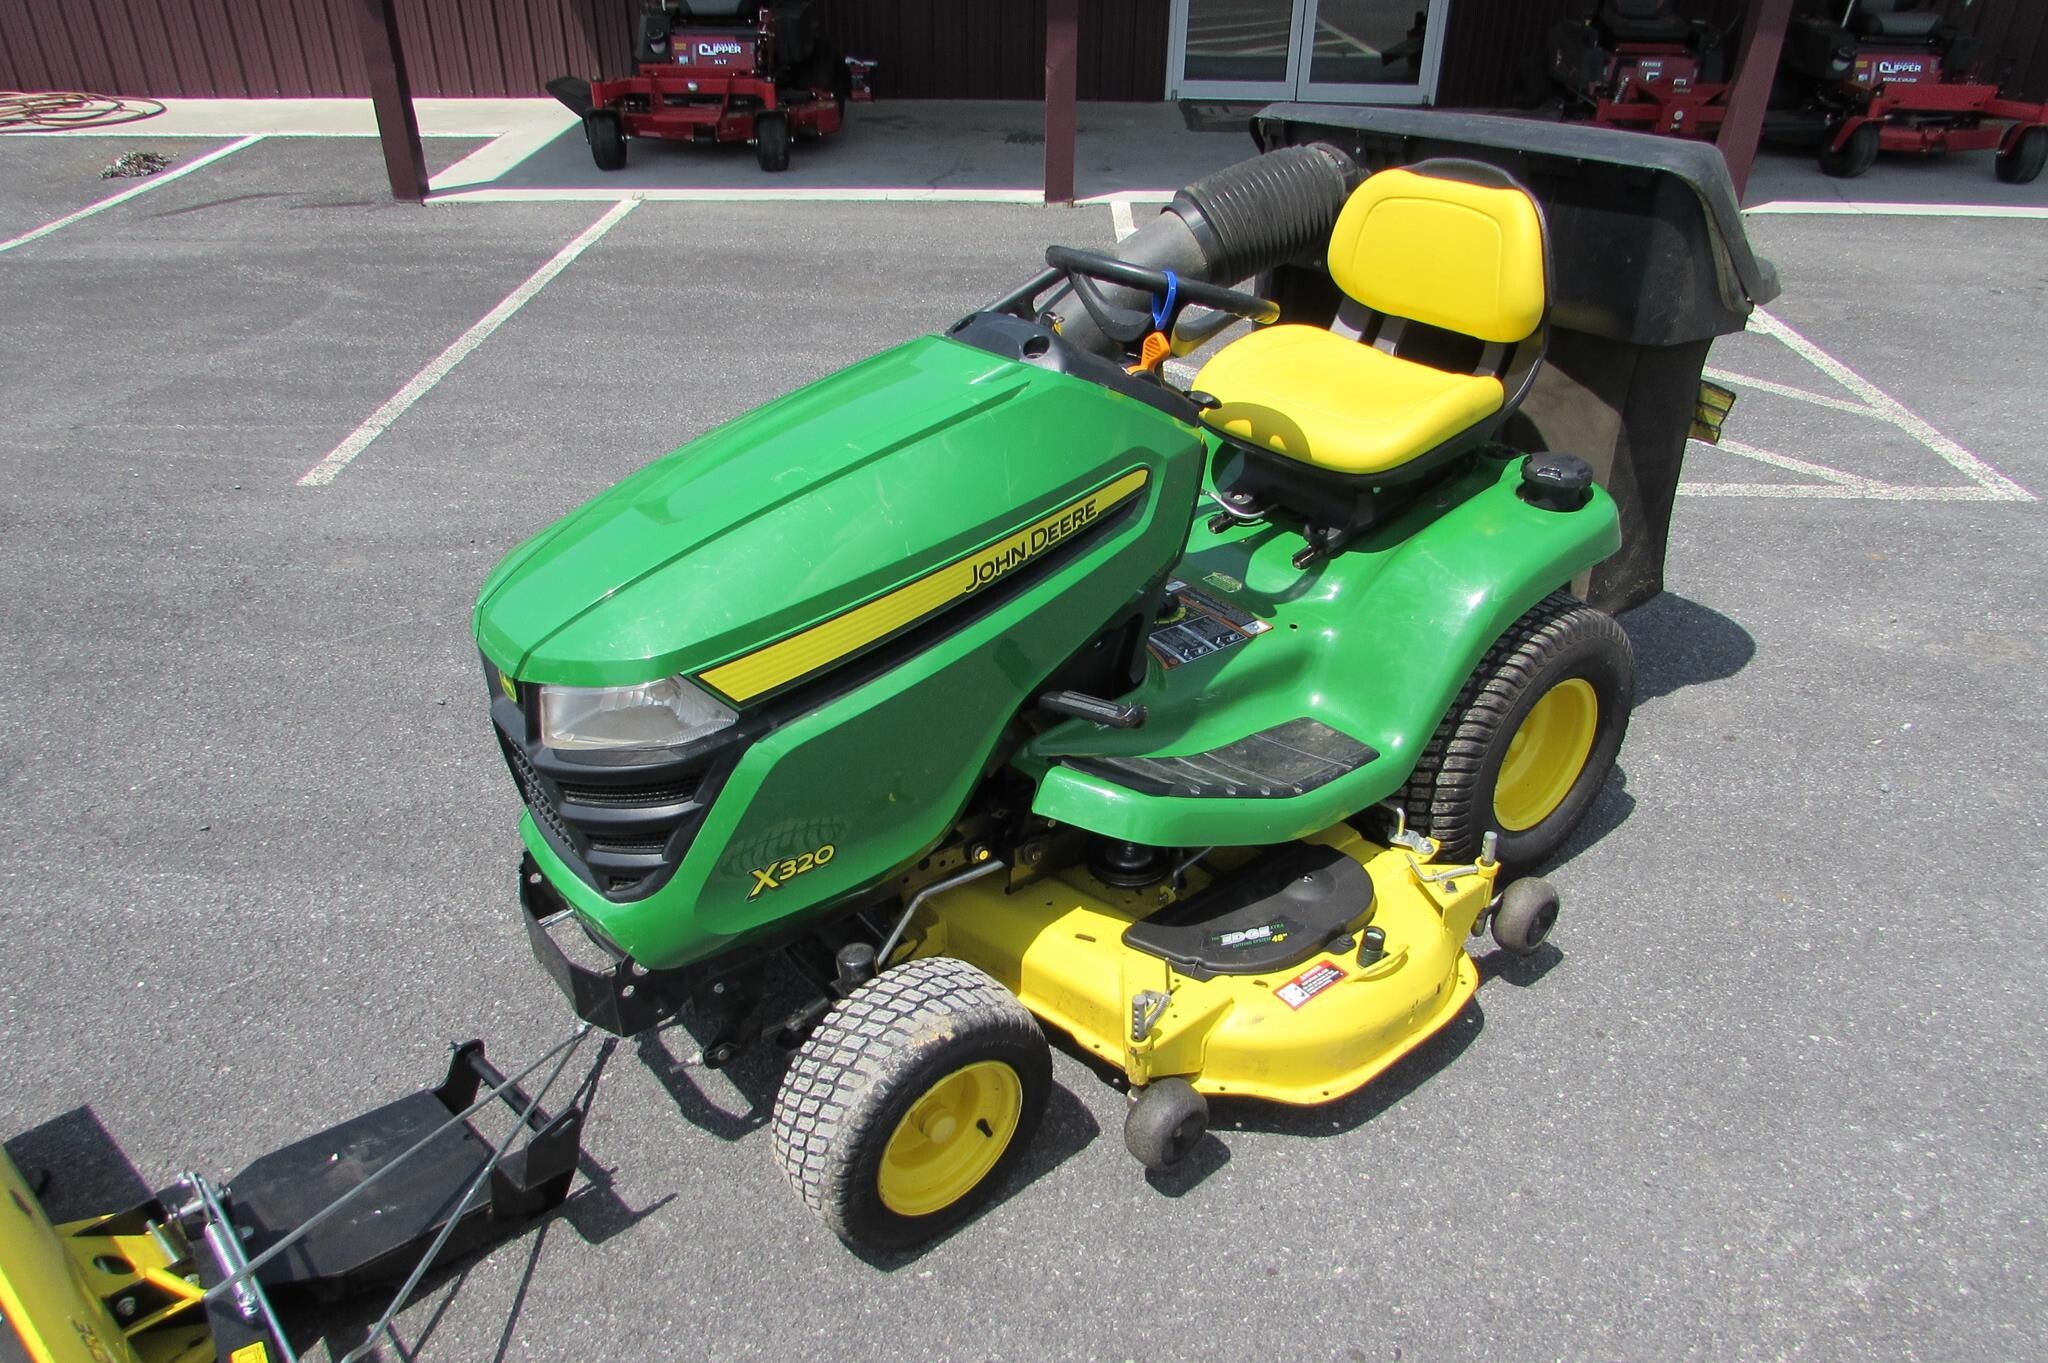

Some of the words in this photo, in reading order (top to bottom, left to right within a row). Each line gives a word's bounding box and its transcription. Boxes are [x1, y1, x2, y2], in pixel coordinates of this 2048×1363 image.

[698, 43, 741, 56] CLIPPER
[1879, 61, 1922, 74] CLIPPER
[965, 541, 1026, 592] JOHN
[1030, 498, 1098, 552] DEERE
[747, 843, 836, 900] X320
[1220, 925, 1272, 946] EDGE
